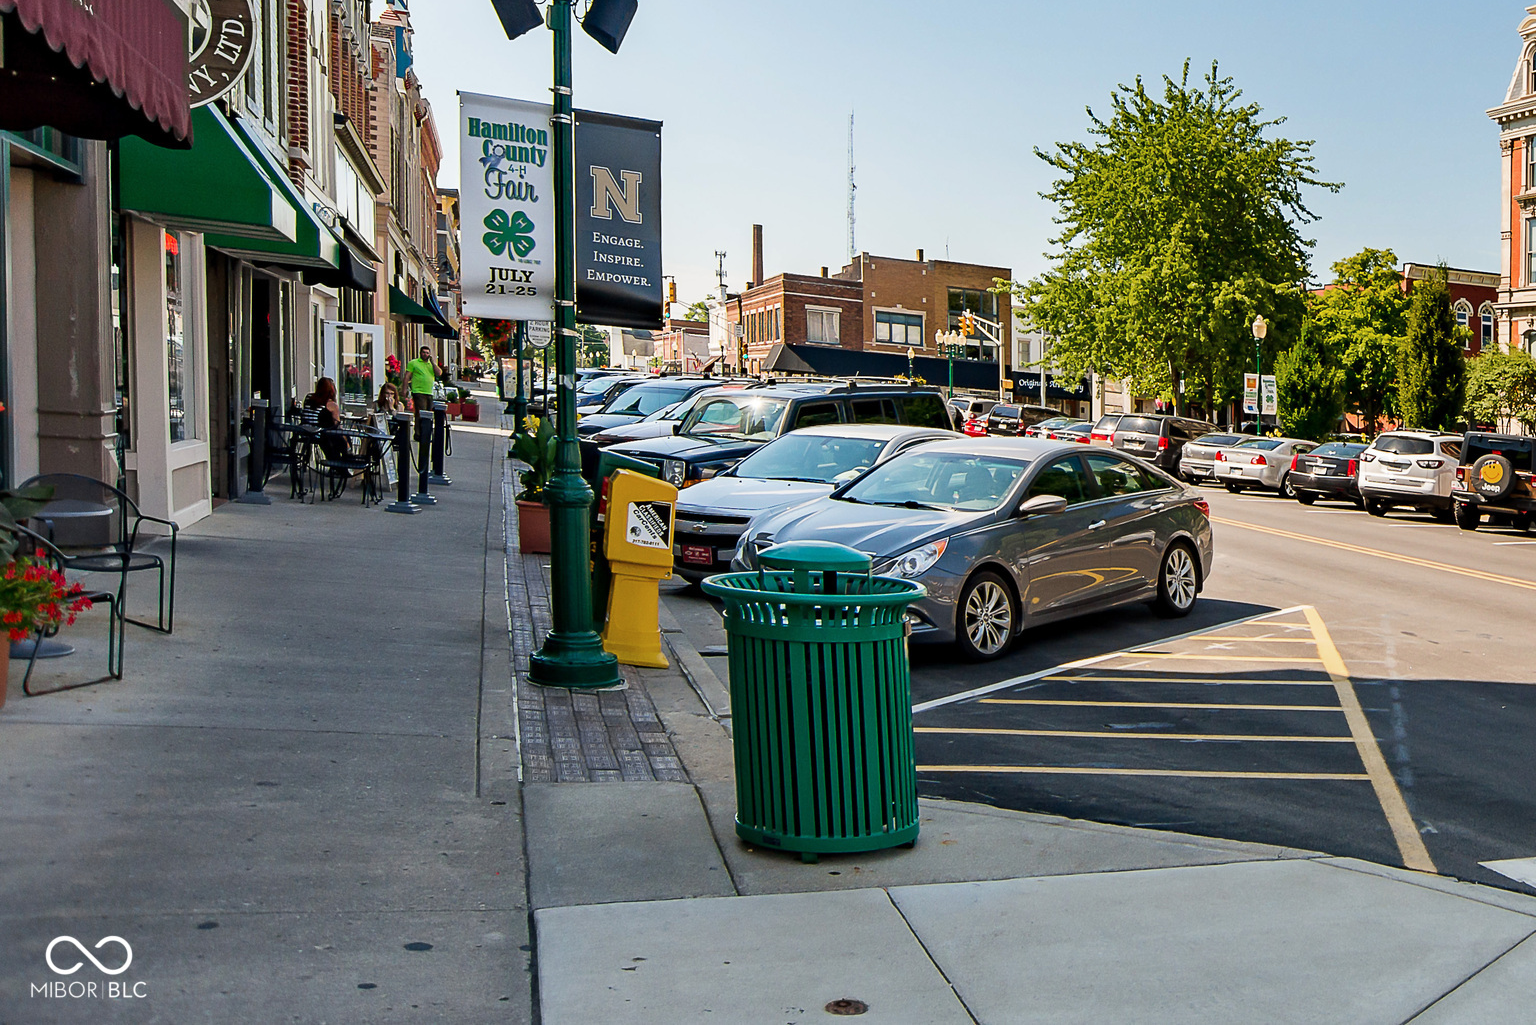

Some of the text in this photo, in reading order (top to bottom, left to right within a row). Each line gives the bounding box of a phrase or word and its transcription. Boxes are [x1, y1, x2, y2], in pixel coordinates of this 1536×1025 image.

[214, 14, 246, 65] LTD.
[467, 117, 548, 147] Hamilton
[482, 139, 547, 167] County
[508, 164, 528, 175] 4-H
[484, 168, 539, 203] Fair
[589, 165, 643, 224] N
[592, 231, 644, 249] ENGAGE.
[593, 250, 644, 268] INSPIRE.
[488, 266, 535, 284] JULY
[586, 269, 651, 288] EMPOWER.
[485, 283, 537, 297] 21-25
[529, 326, 550, 334] PARKING
[1481, 483, 1501, 493] Jeep
[632, 509, 657, 540] CarCents
[639, 505, 664, 537] CLASSIFIEDS
[645, 504, 668, 531] AMERICAN
